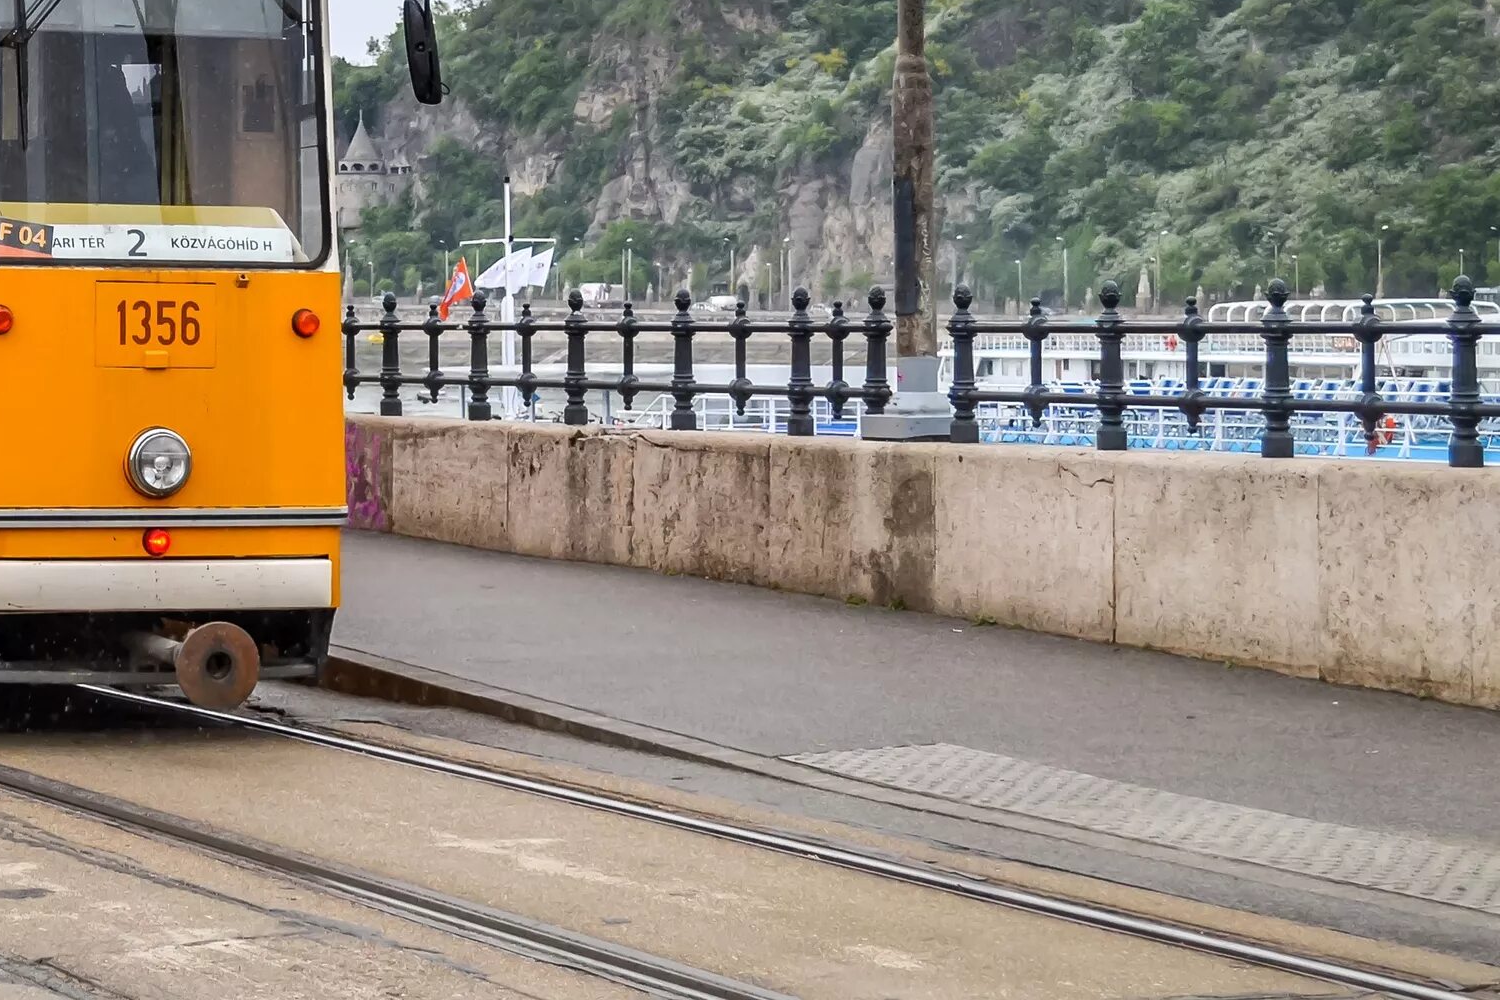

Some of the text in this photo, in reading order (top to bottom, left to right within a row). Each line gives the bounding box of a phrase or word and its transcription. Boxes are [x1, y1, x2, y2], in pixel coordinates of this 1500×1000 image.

[0, 222, 47, 248] F 04
[52, 229, 273, 257] ARI TÉR 2 KÖZVÁGÓHÍD H
[117, 300, 200, 346] 1356
